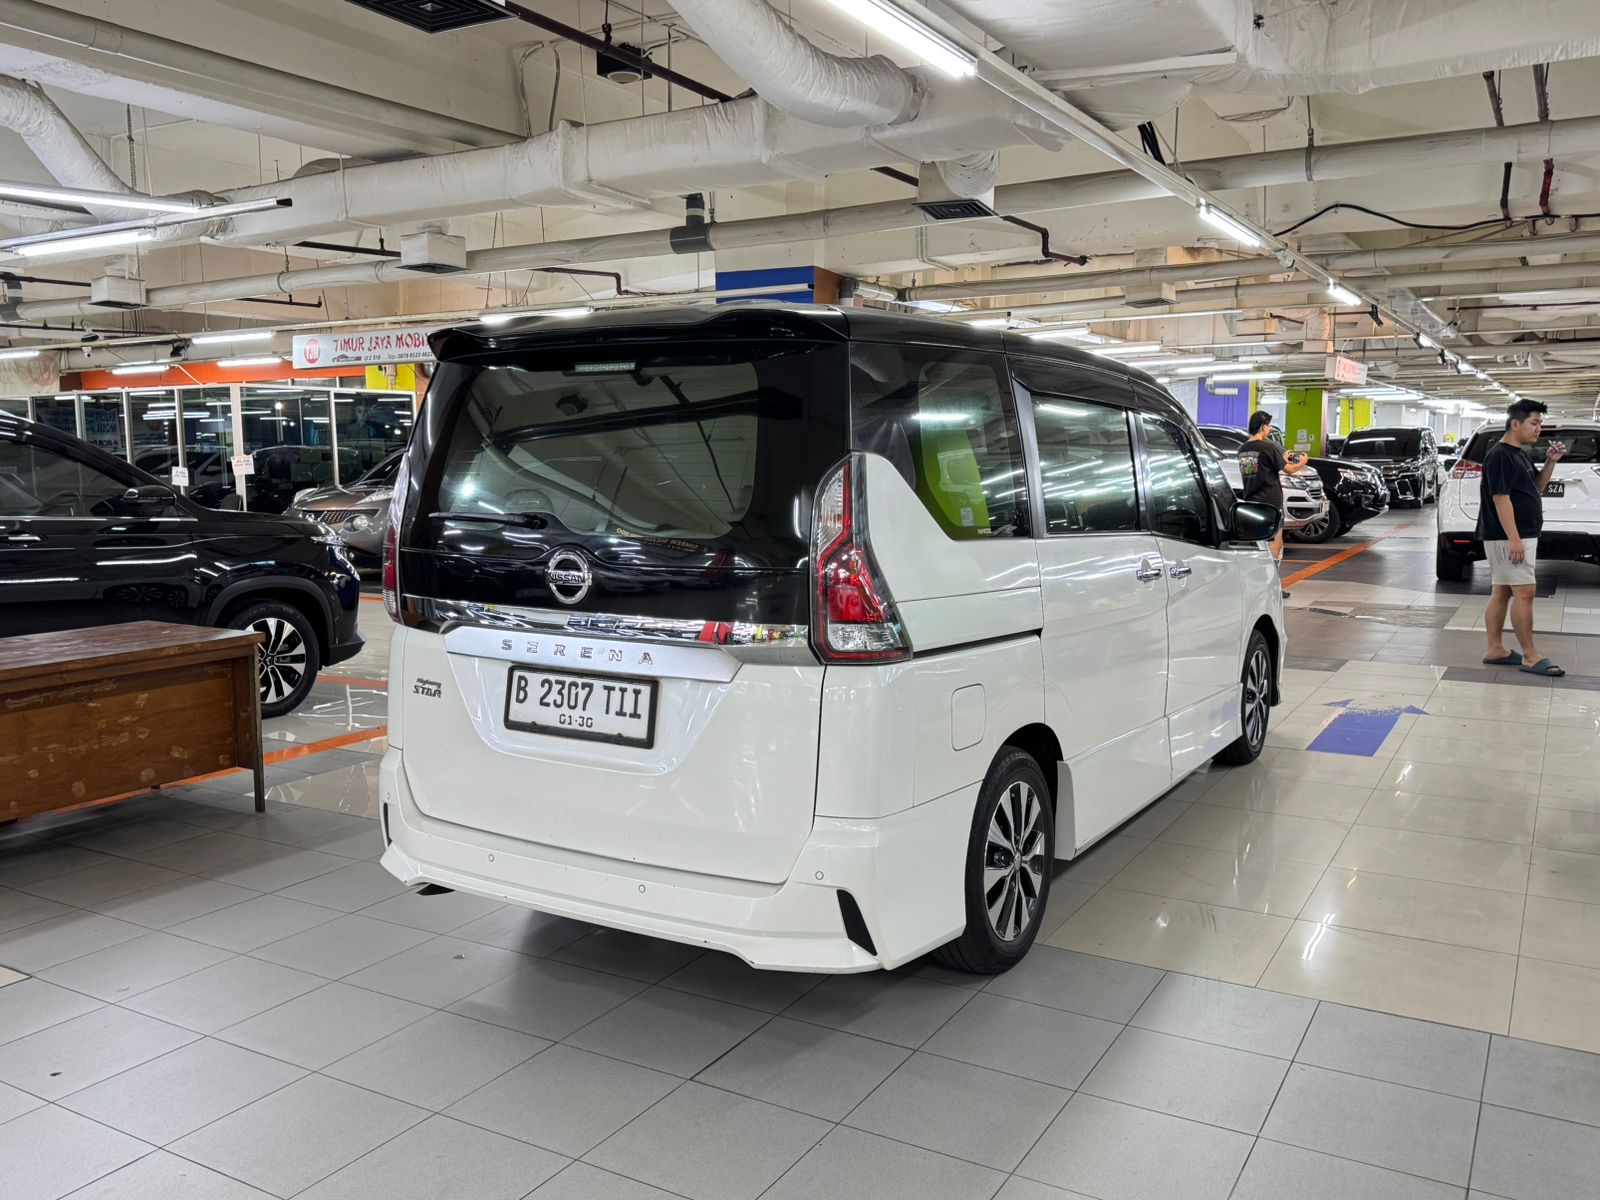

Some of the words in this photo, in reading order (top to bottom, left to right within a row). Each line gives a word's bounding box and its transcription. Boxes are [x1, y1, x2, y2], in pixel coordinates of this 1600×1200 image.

[333, 338, 364, 352] TIMUR
[368, 335, 392, 351] JAYA
[1548, 484, 1564, 493] SZA
[545, 572, 586, 583] NISSAN
[501, 639, 654, 665] SERENA
[412, 685, 442, 699] STAR
[515, 675, 529, 704] B
[539, 678, 594, 711] 2307
[602, 685, 642, 719] TII
